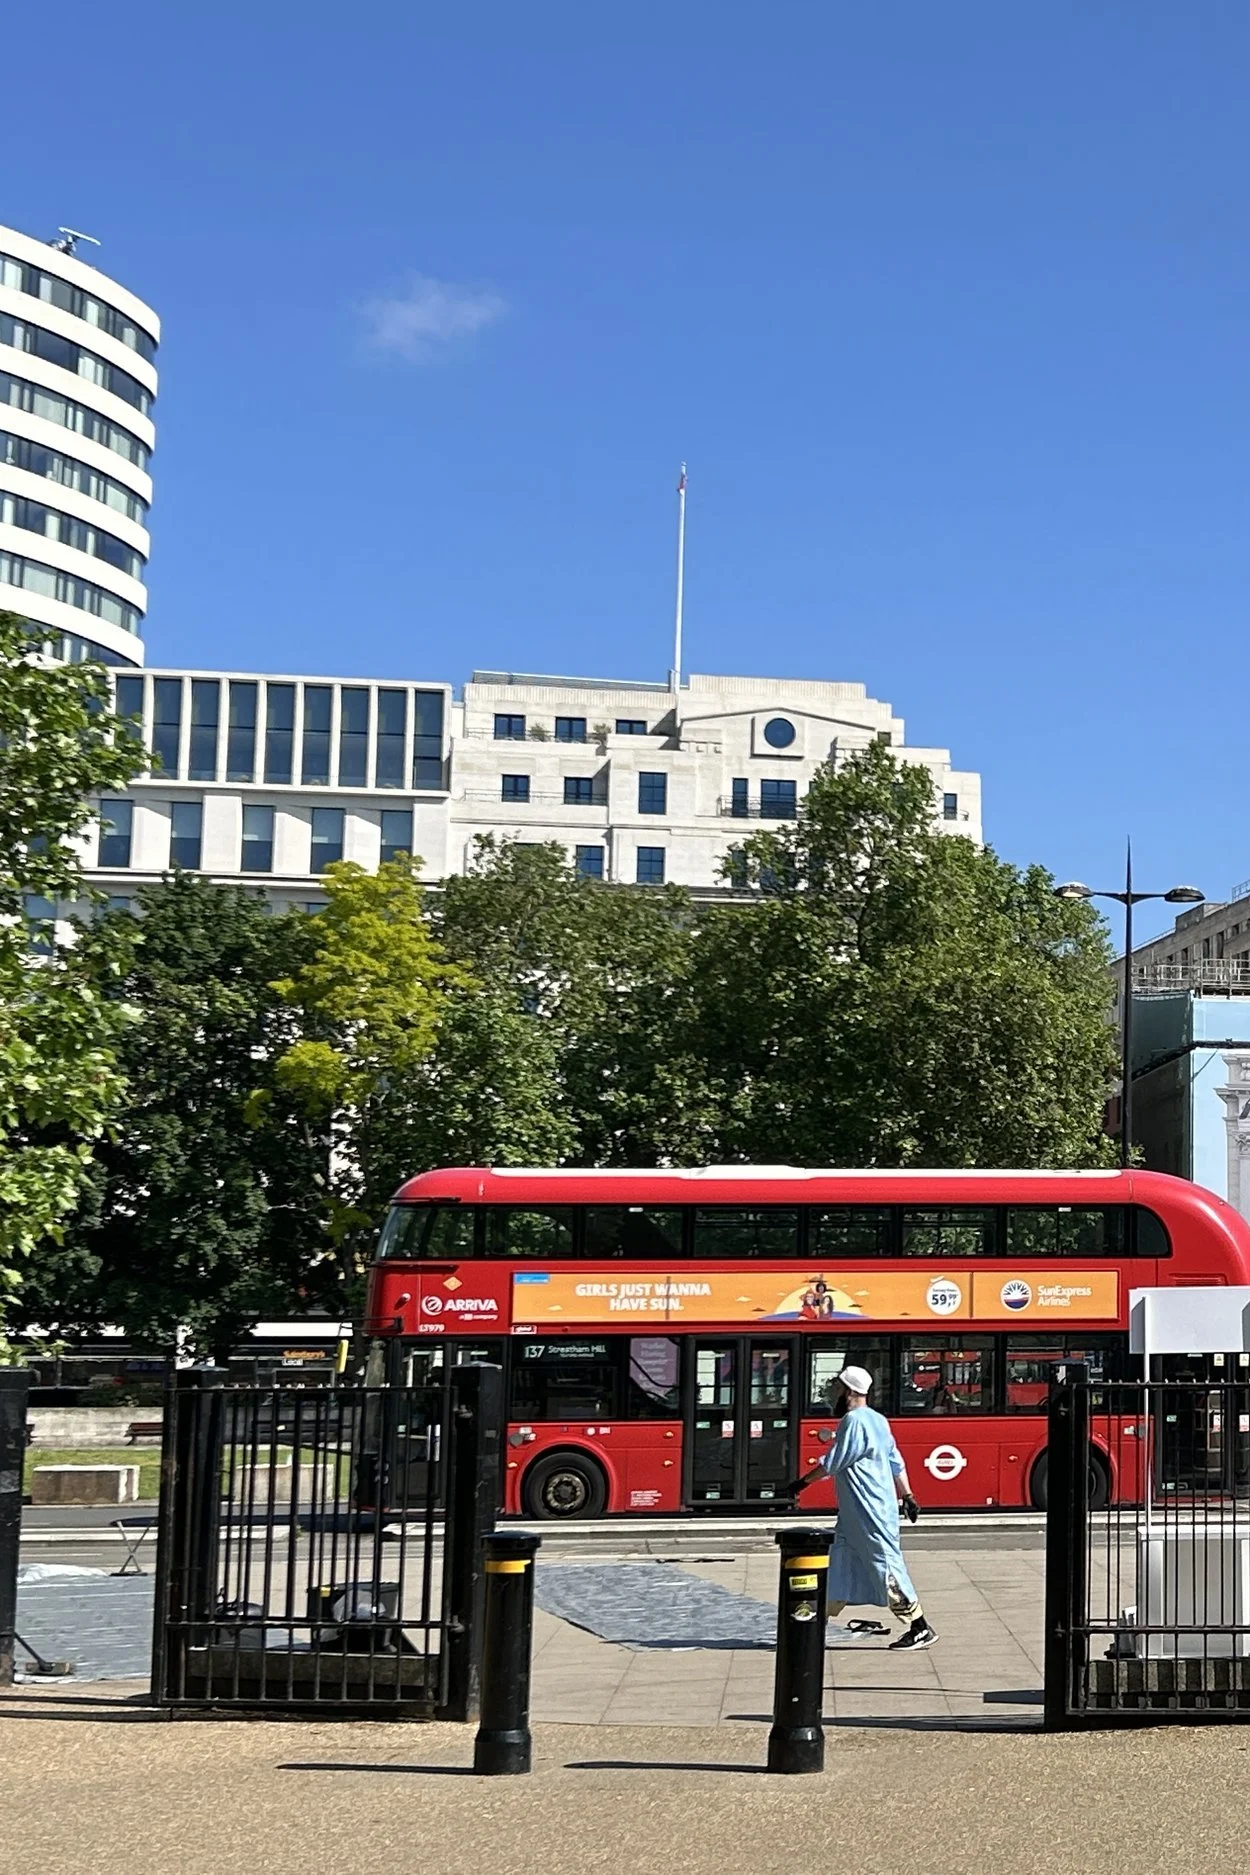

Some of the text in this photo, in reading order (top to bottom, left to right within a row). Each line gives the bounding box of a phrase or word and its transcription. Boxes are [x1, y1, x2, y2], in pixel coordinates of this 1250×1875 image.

[575, 1283, 711, 1298] GIRLS JUST WANNA
[1037, 1285, 1092, 1298] SunExpress
[443, 1299, 499, 1311] ARRIVA
[609, 1297, 684, 1311] HAVE SUN.
[1037, 1296, 1071, 1307] Airlines
[524, 1345, 546, 1358] 137
